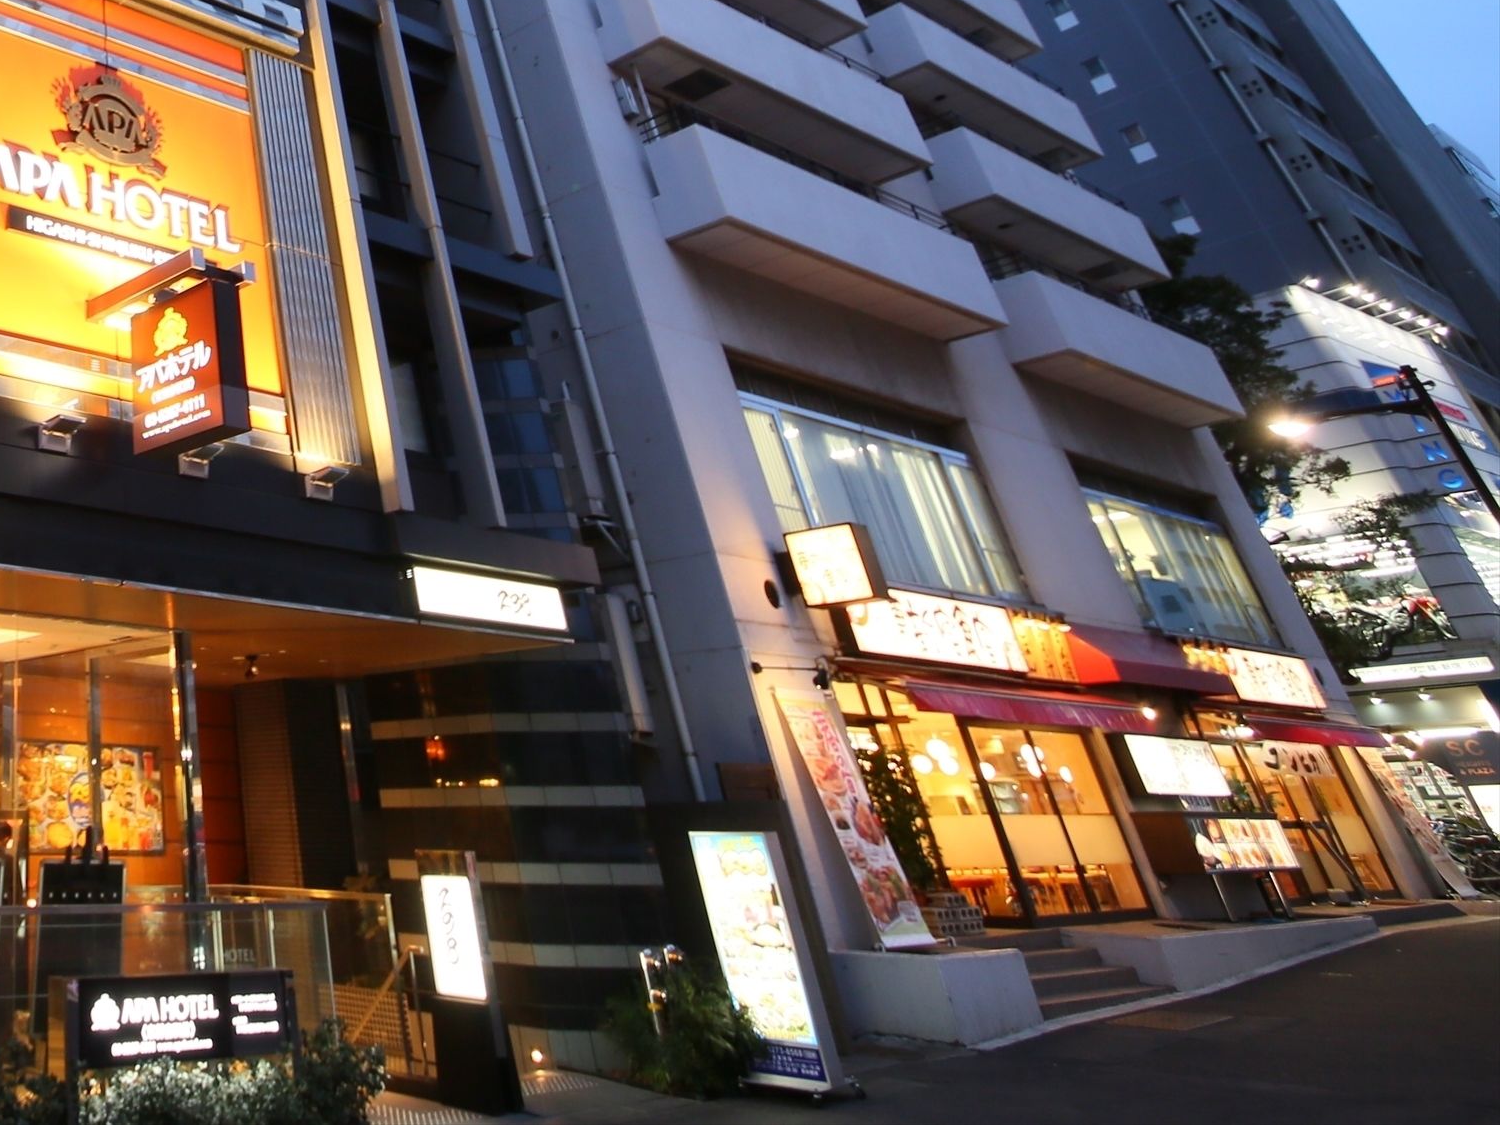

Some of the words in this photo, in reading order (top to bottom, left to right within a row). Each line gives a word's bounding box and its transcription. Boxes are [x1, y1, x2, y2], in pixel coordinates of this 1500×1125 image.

[89, 172, 242, 254] HOTEL
[135, 339, 212, 394] アパホテル
[1444, 738, 1485, 756] SC
[120, 996, 160, 1025] APA
[159, 993, 220, 1022] HOTEL
